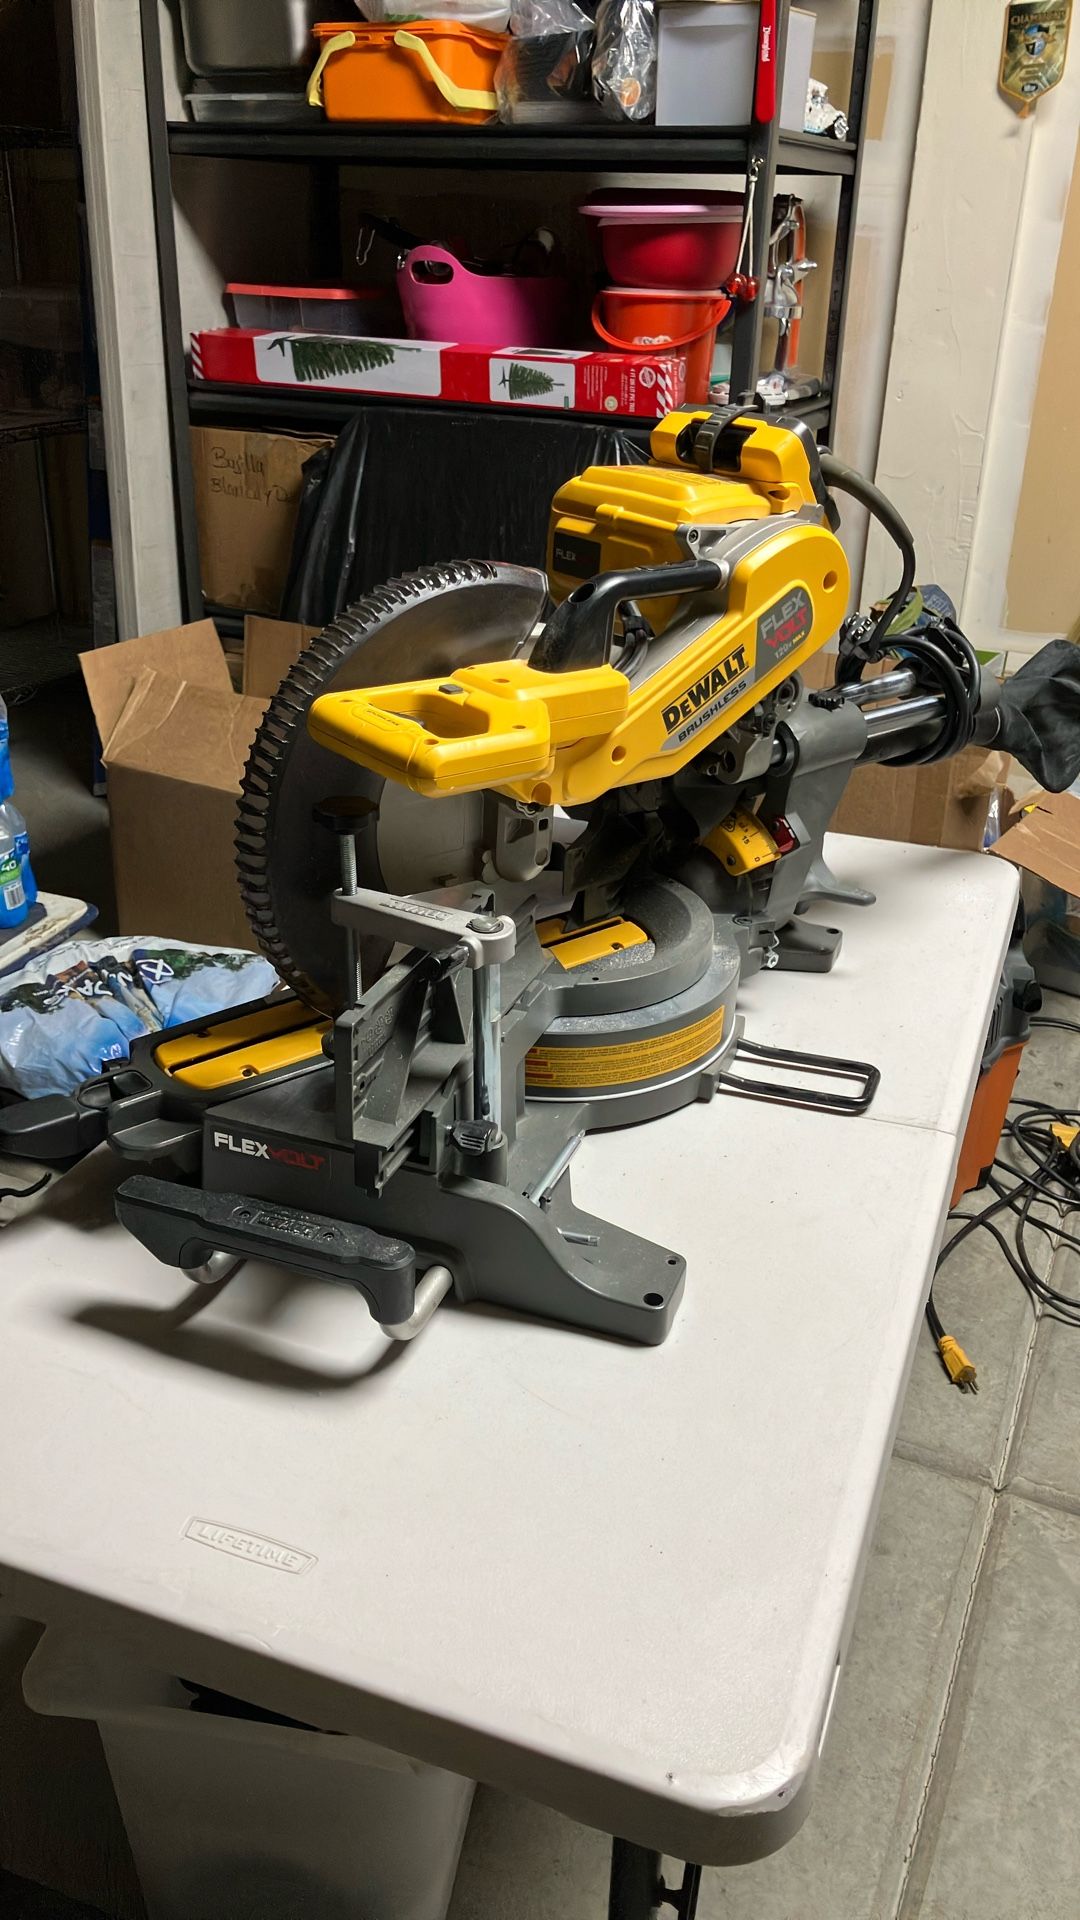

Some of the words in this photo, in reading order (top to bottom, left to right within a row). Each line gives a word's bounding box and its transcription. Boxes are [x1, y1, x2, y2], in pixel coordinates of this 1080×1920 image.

[760, 590, 805, 640] FLEX
[766, 606, 808, 649] VOLT
[678, 680, 747, 742] BRUSHLESS
[197, 1525, 298, 1568] LIFETIME
